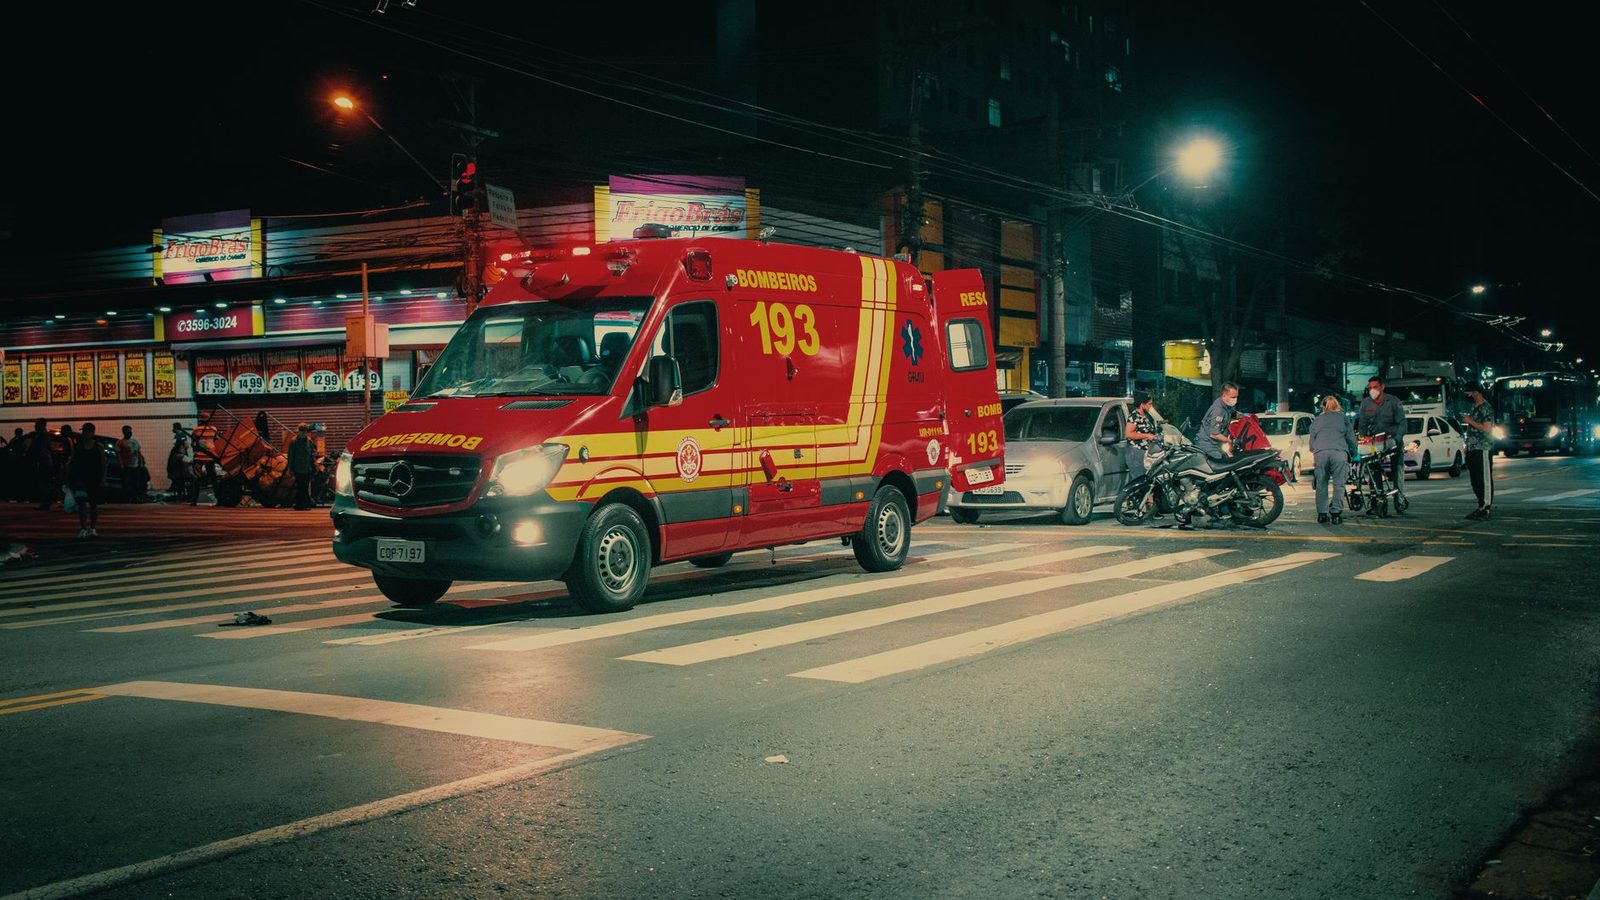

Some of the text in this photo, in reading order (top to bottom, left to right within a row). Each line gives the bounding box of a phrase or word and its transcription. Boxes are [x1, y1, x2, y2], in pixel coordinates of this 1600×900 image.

[736, 269, 817, 292] BOMBEIROS
[186, 315, 237, 332] 3596-3024
[750, 301, 820, 356] 193
[977, 403, 1002, 417] BOMB
[967, 430, 999, 455] 193
